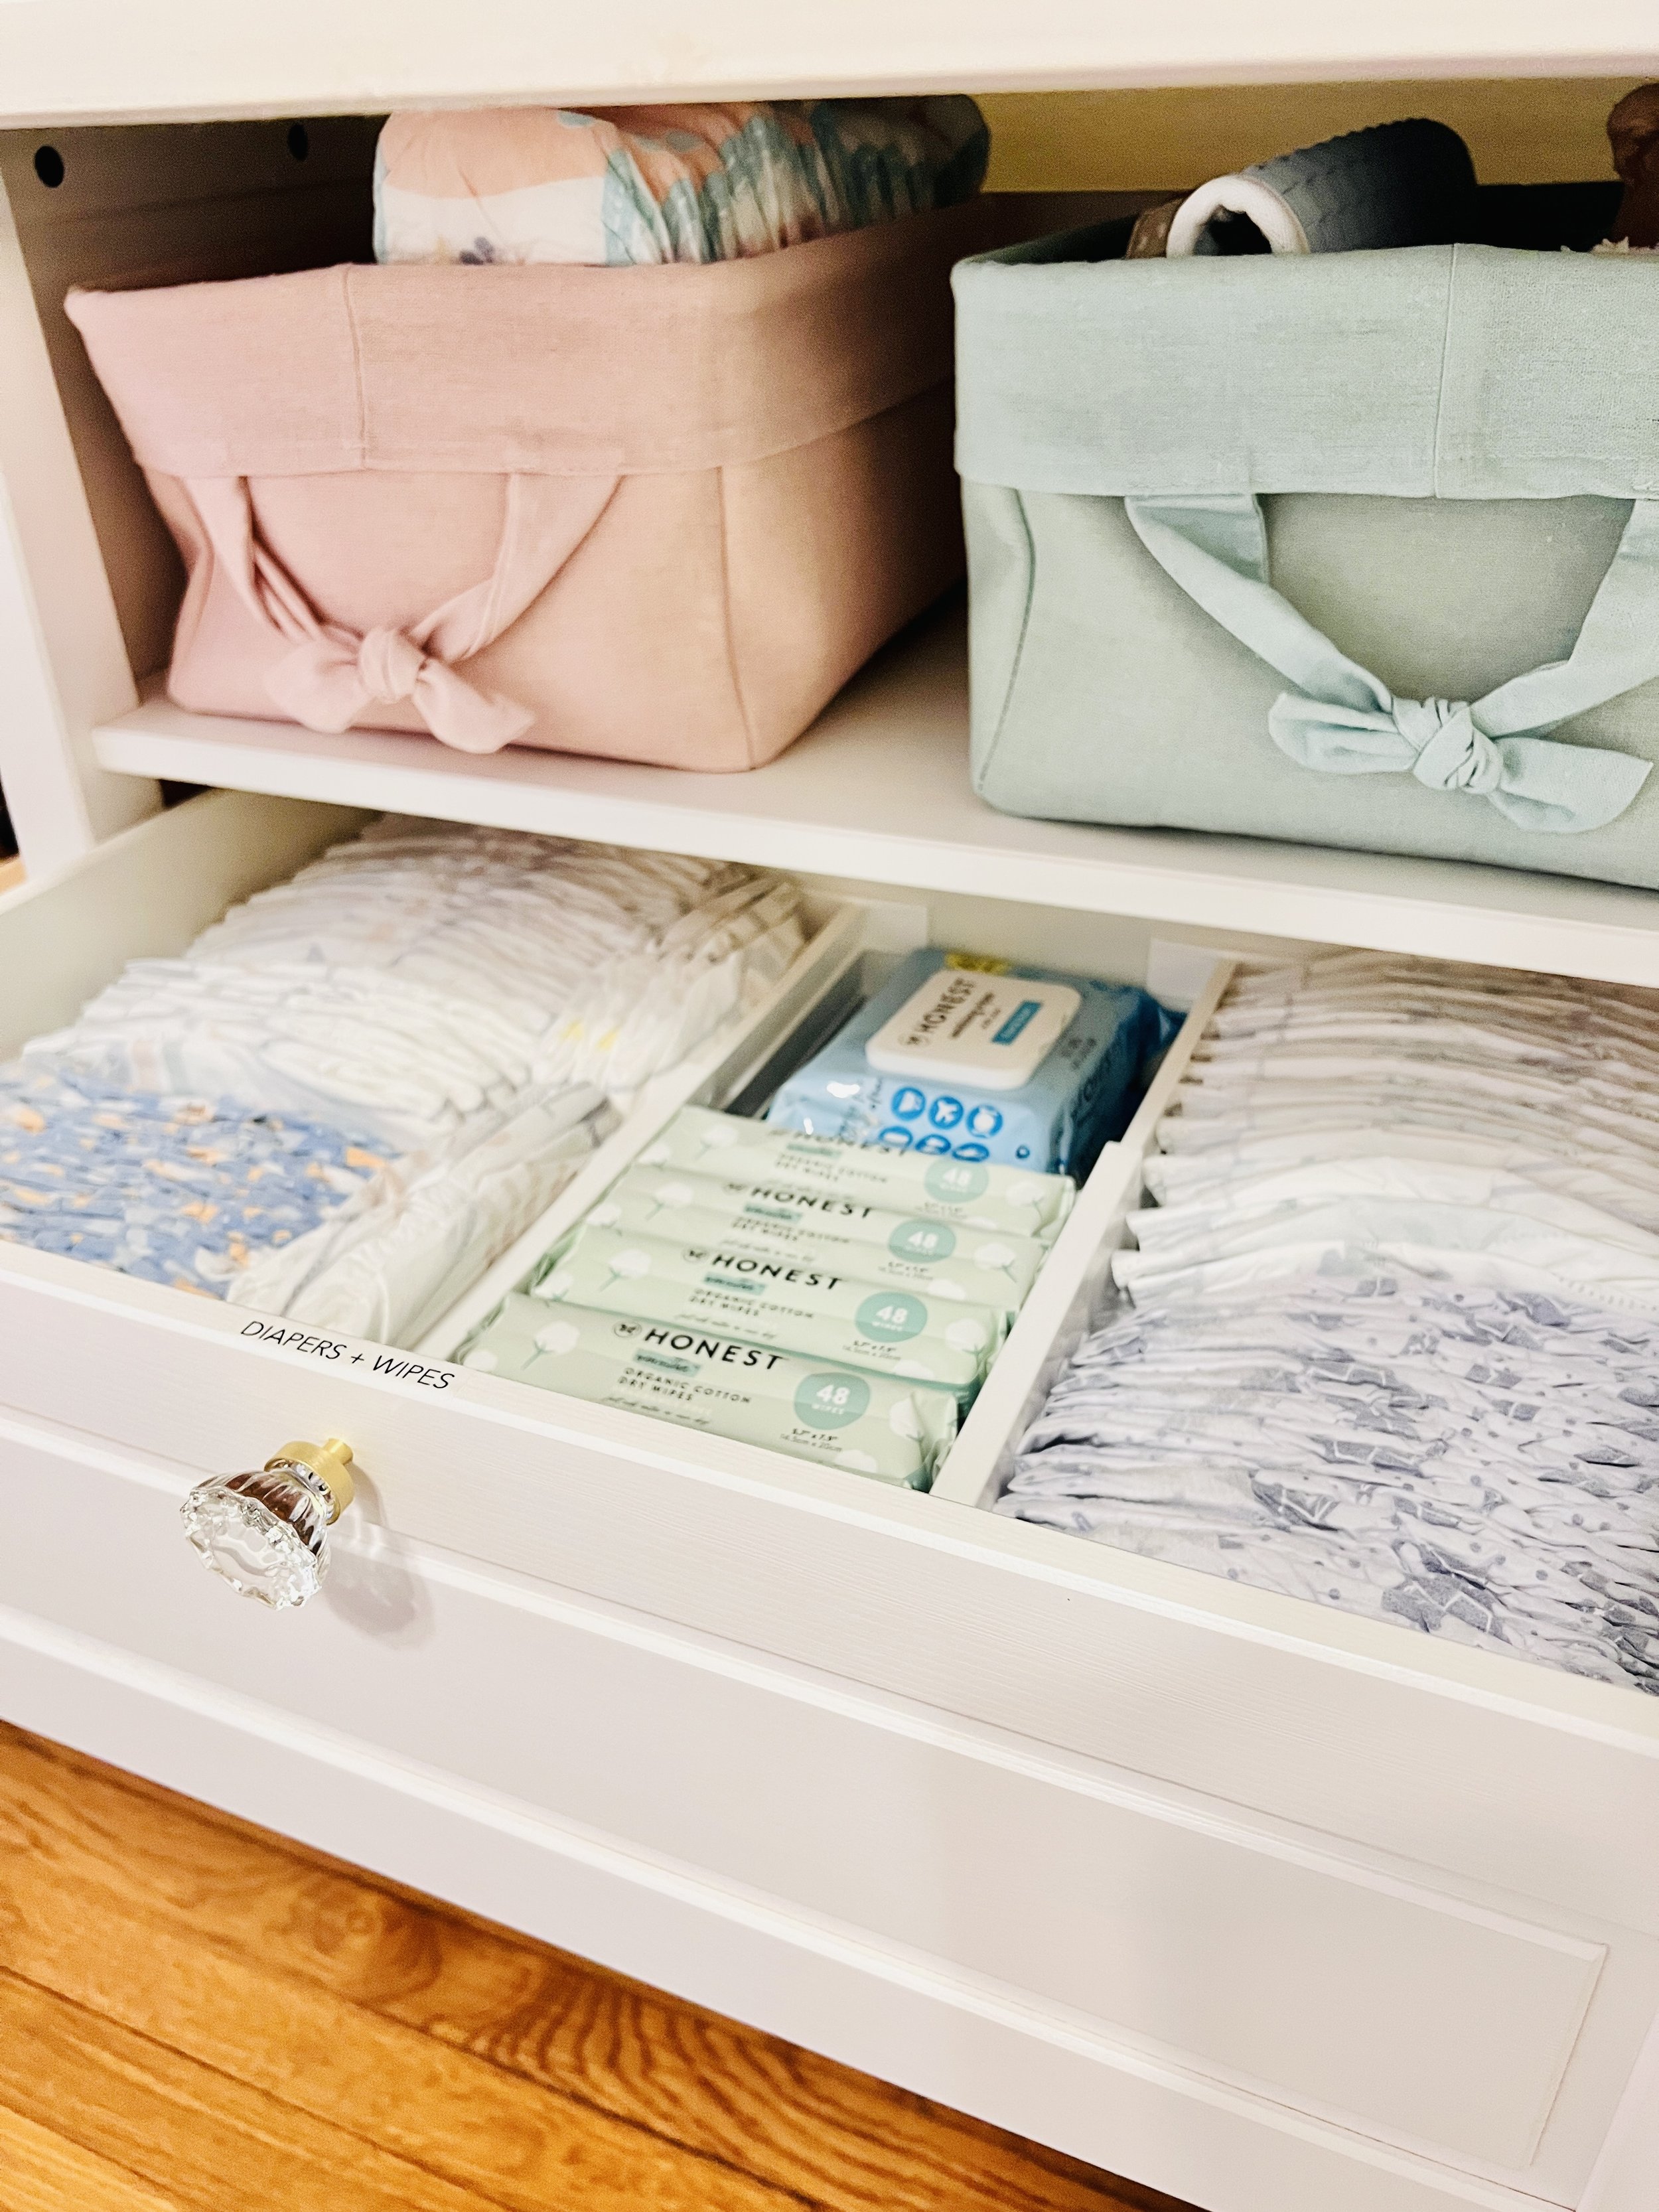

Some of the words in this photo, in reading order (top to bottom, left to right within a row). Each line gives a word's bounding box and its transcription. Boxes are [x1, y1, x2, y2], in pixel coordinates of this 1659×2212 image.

[943, 1168, 972, 1185] 48
[751, 1187, 873, 1219] HONEST
[907, 1231, 939, 1249] 48
[711, 1254, 846, 1290] HONEST
[875, 1305, 908, 1324] 48
[240, 1320, 347, 1359] DIAPERS
[350, 1353, 364, 1364] +
[373, 1355, 456, 1389] WIPES
[644, 1328, 786, 1370] HONEST
[617, 1375, 646, 1391] DRY
[651, 1384, 694, 1402] WIPES
[624, 1366, 690, 1390] ORGANIC
[693, 1384, 752, 1404] COTTON
[816, 1384, 851, 1406] 48
